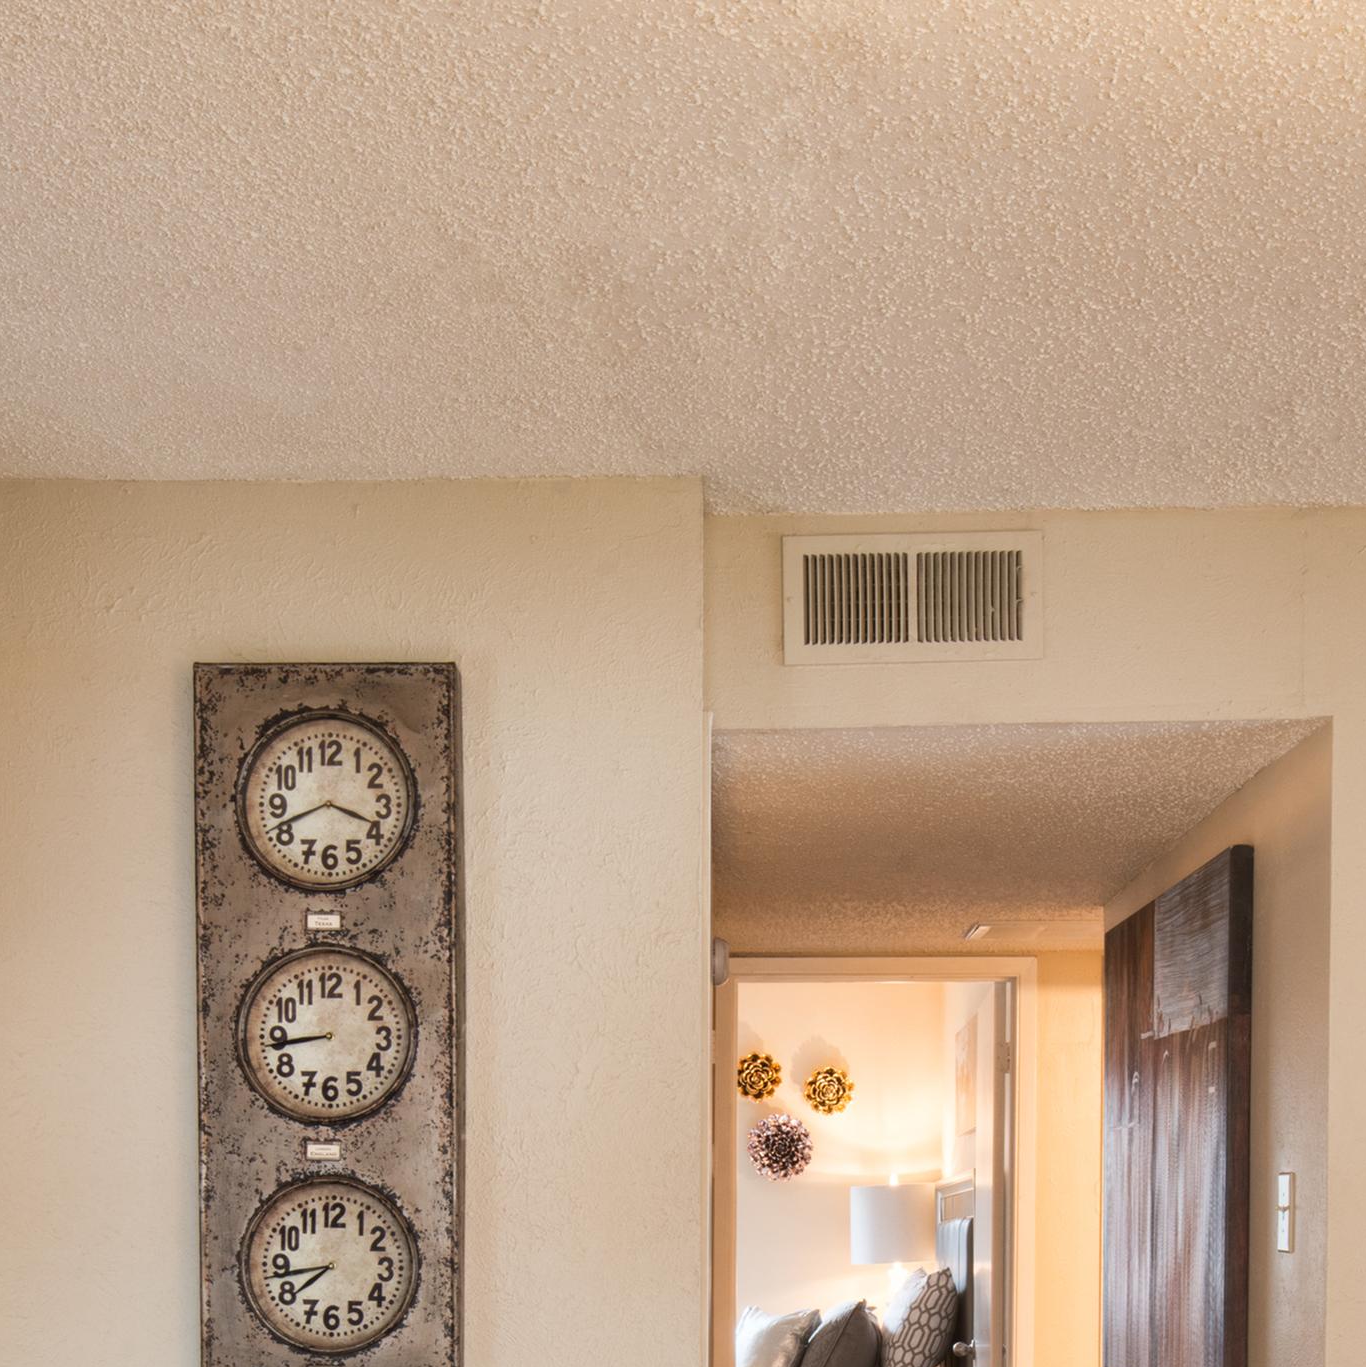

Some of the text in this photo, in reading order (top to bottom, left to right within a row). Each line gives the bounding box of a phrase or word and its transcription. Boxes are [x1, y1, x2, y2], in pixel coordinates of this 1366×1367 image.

[297, 747, 313, 773] 11
[319, 740, 343, 766] 12
[353, 747, 361, 774] 1
[275, 765, 296, 791] 10
[367, 763, 384, 789] 2
[268, 793, 287, 819] 9
[375, 794, 392, 820] 3
[276, 821, 295, 847] 8
[366, 820, 384, 846] 4
[300, 840, 317, 865] 7
[321, 845, 339, 871] 6
[346, 840, 363, 866] 5
[297, 979, 313, 1005] 11
[319, 972, 343, 999] 12
[353, 979, 361, 1006] 1
[275, 997, 297, 1023] 10
[367, 995, 384, 1021] 2
[269, 1025, 288, 1050] 9
[375, 1026, 392, 1052] 3
[276, 1053, 295, 1078] 8
[366, 1053, 384, 1078] 4
[301, 1071, 318, 1097] 7
[321, 1076, 339, 1102] 6
[346, 1071, 363, 1097] 5
[300, 1208, 317, 1235] 11
[322, 1202, 346, 1229] 12
[356, 1210, 364, 1237] 1
[278, 1225, 300, 1251] 10
[370, 1226, 386, 1252] 2
[272, 1253, 291, 1277] 9
[377, 1256, 394, 1283] 3
[278, 1281, 296, 1306] 8
[367, 1283, 386, 1308] 4
[303, 1299, 319, 1325] 7
[322, 1305, 340, 1331] 6
[347, 1301, 364, 1327] 5
